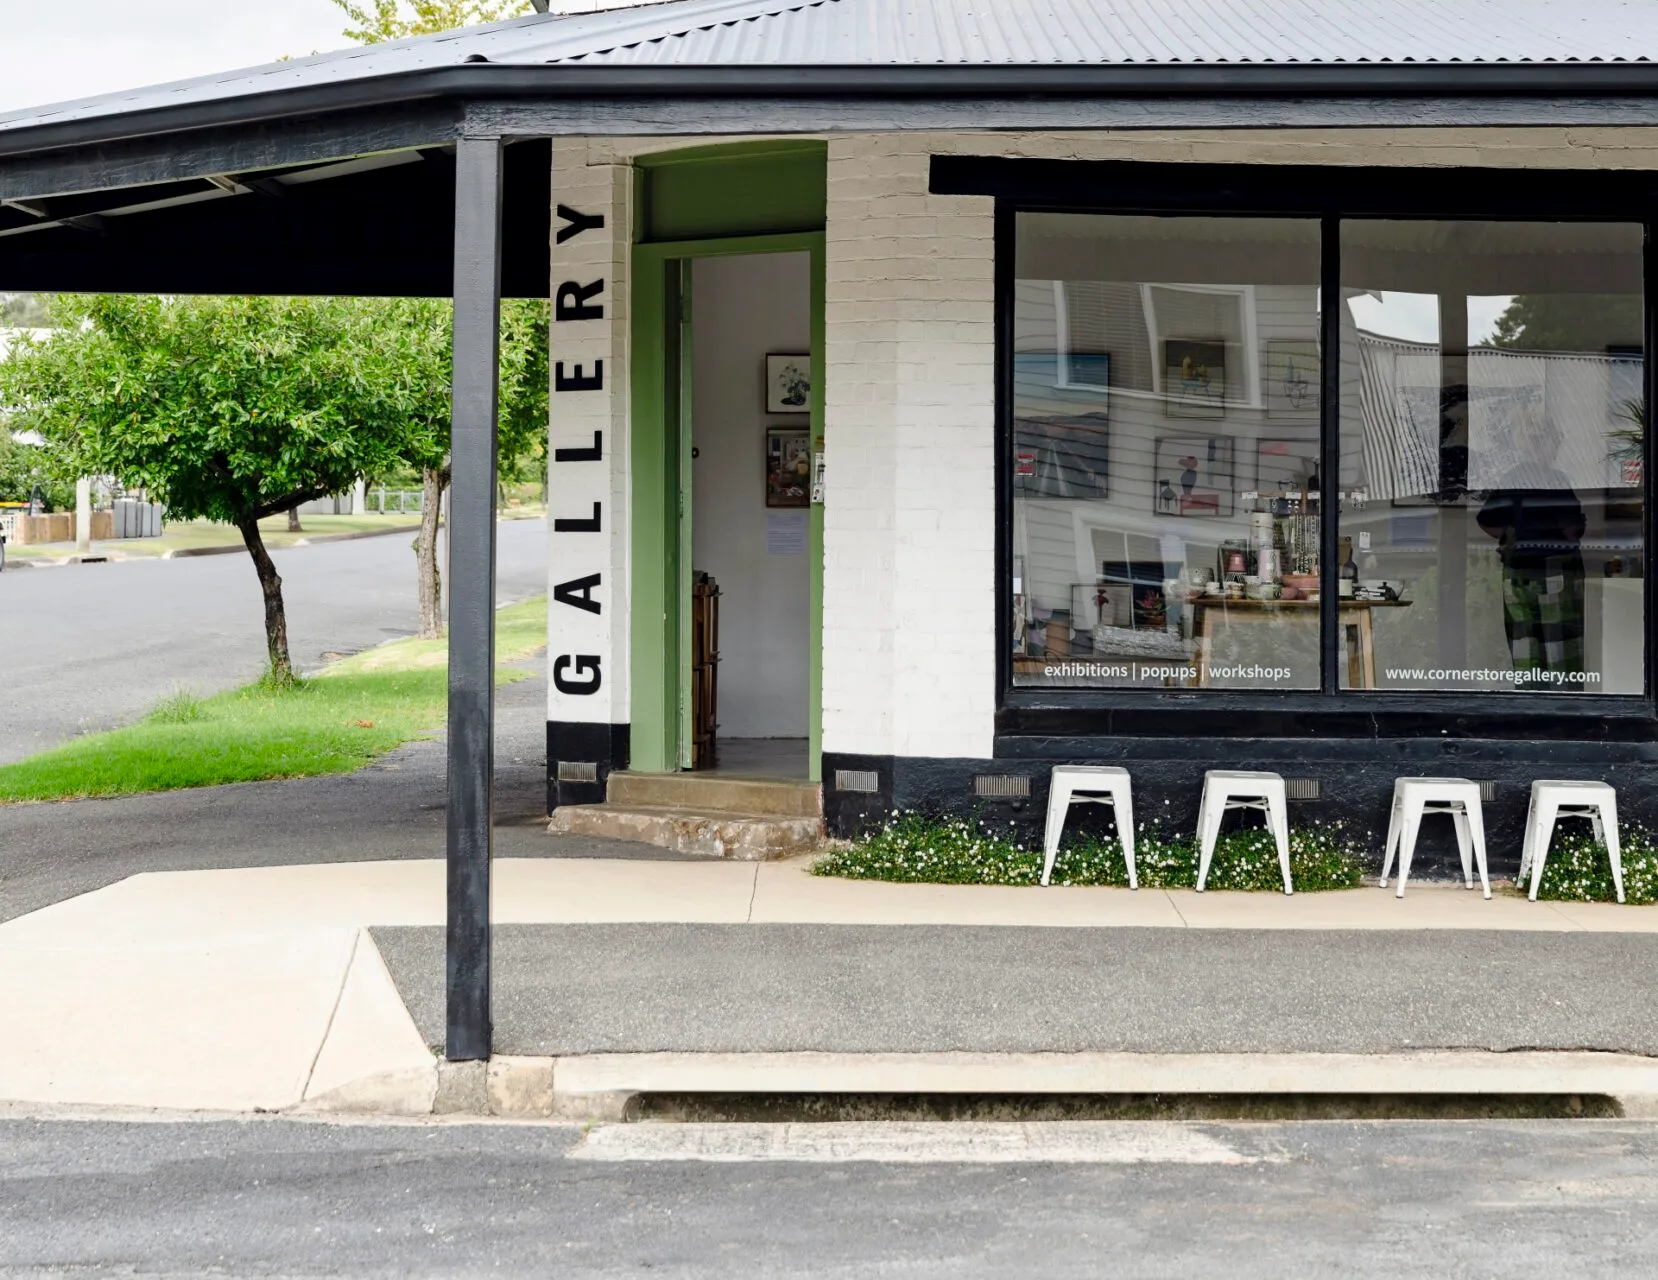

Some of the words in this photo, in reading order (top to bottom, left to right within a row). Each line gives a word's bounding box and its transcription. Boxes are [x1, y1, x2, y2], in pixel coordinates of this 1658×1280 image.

[553, 203, 605, 696] GALLERY
[1044, 662, 1128, 677] exhibitions
[1140, 664, 1197, 681] popups
[1209, 663, 1291, 681] workshops
[1385, 667, 1601, 685] www.cornerstoregallery.com
